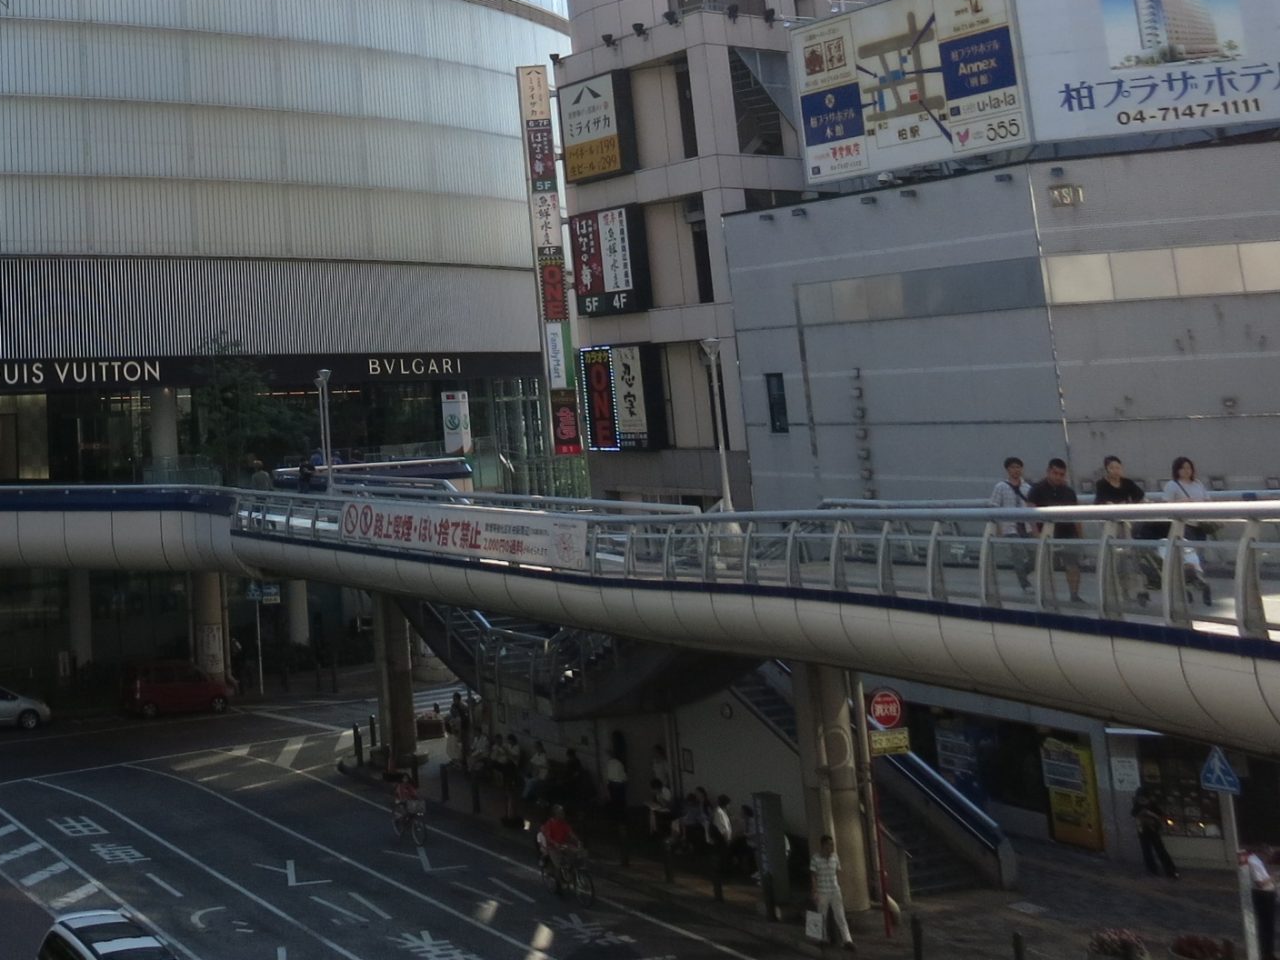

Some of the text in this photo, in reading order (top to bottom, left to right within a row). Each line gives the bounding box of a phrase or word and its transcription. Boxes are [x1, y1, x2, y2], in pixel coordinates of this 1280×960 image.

[958, 57, 998, 76] Annex
[1117, 98, 1261, 125] 04-7147-1111
[569, 114, 611, 137] ミライザカ
[536, 182, 551, 190] 5F
[544, 247, 556, 255] 4F
[585, 297, 599, 313] 5F
[613, 293, 627, 309] 4F
[550, 332, 562, 379] FamilyMart
[54, 361, 160, 383] VUITTON
[369, 358, 461, 375] BVLGARI
